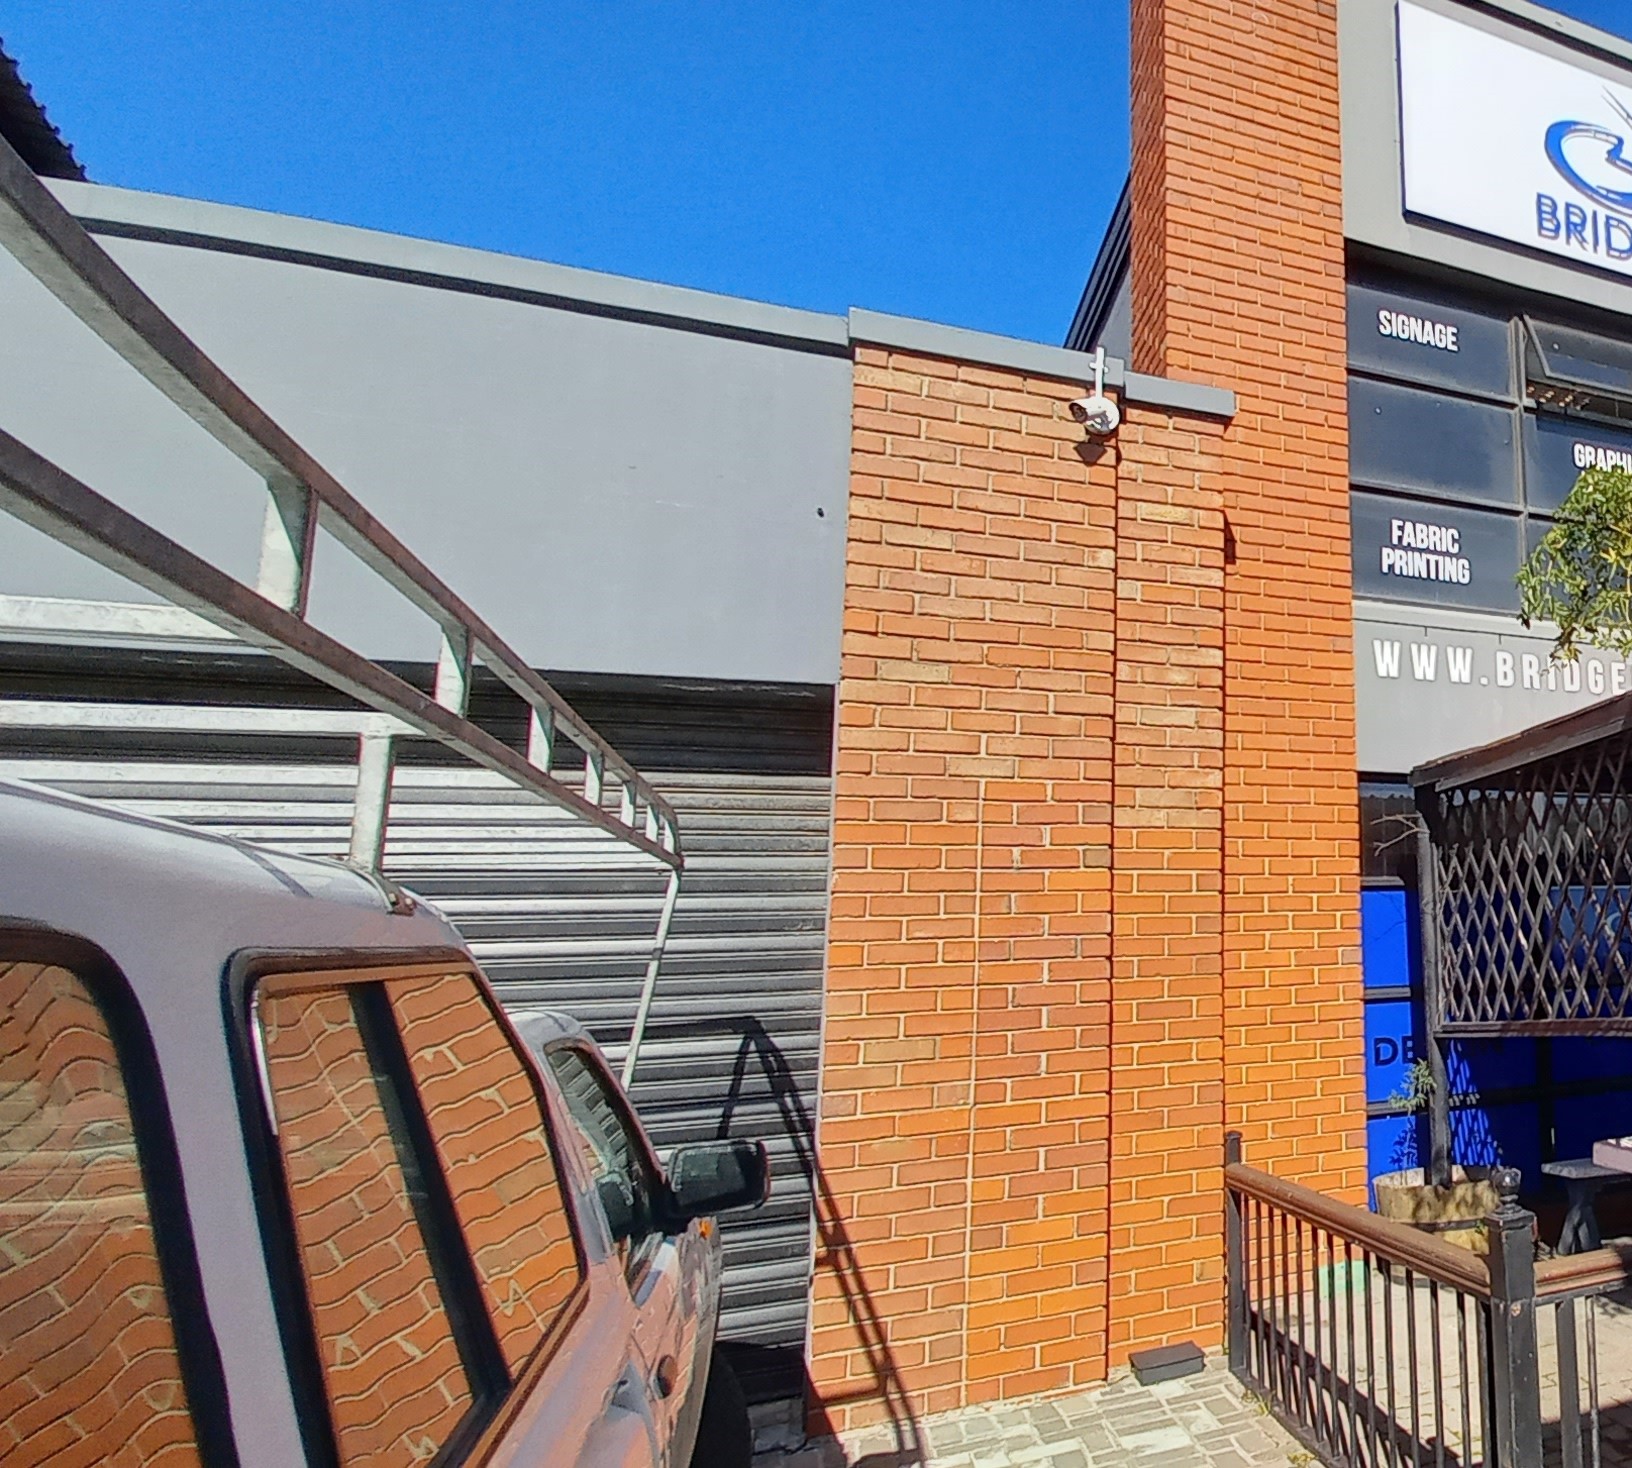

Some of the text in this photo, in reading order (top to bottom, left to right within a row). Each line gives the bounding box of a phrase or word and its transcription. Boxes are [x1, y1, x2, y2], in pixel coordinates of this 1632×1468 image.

[1378, 309, 1459, 352] SIGNAGE
[1390, 518, 1460, 554] FABRIC
[1381, 546, 1471, 585] PRINTING
